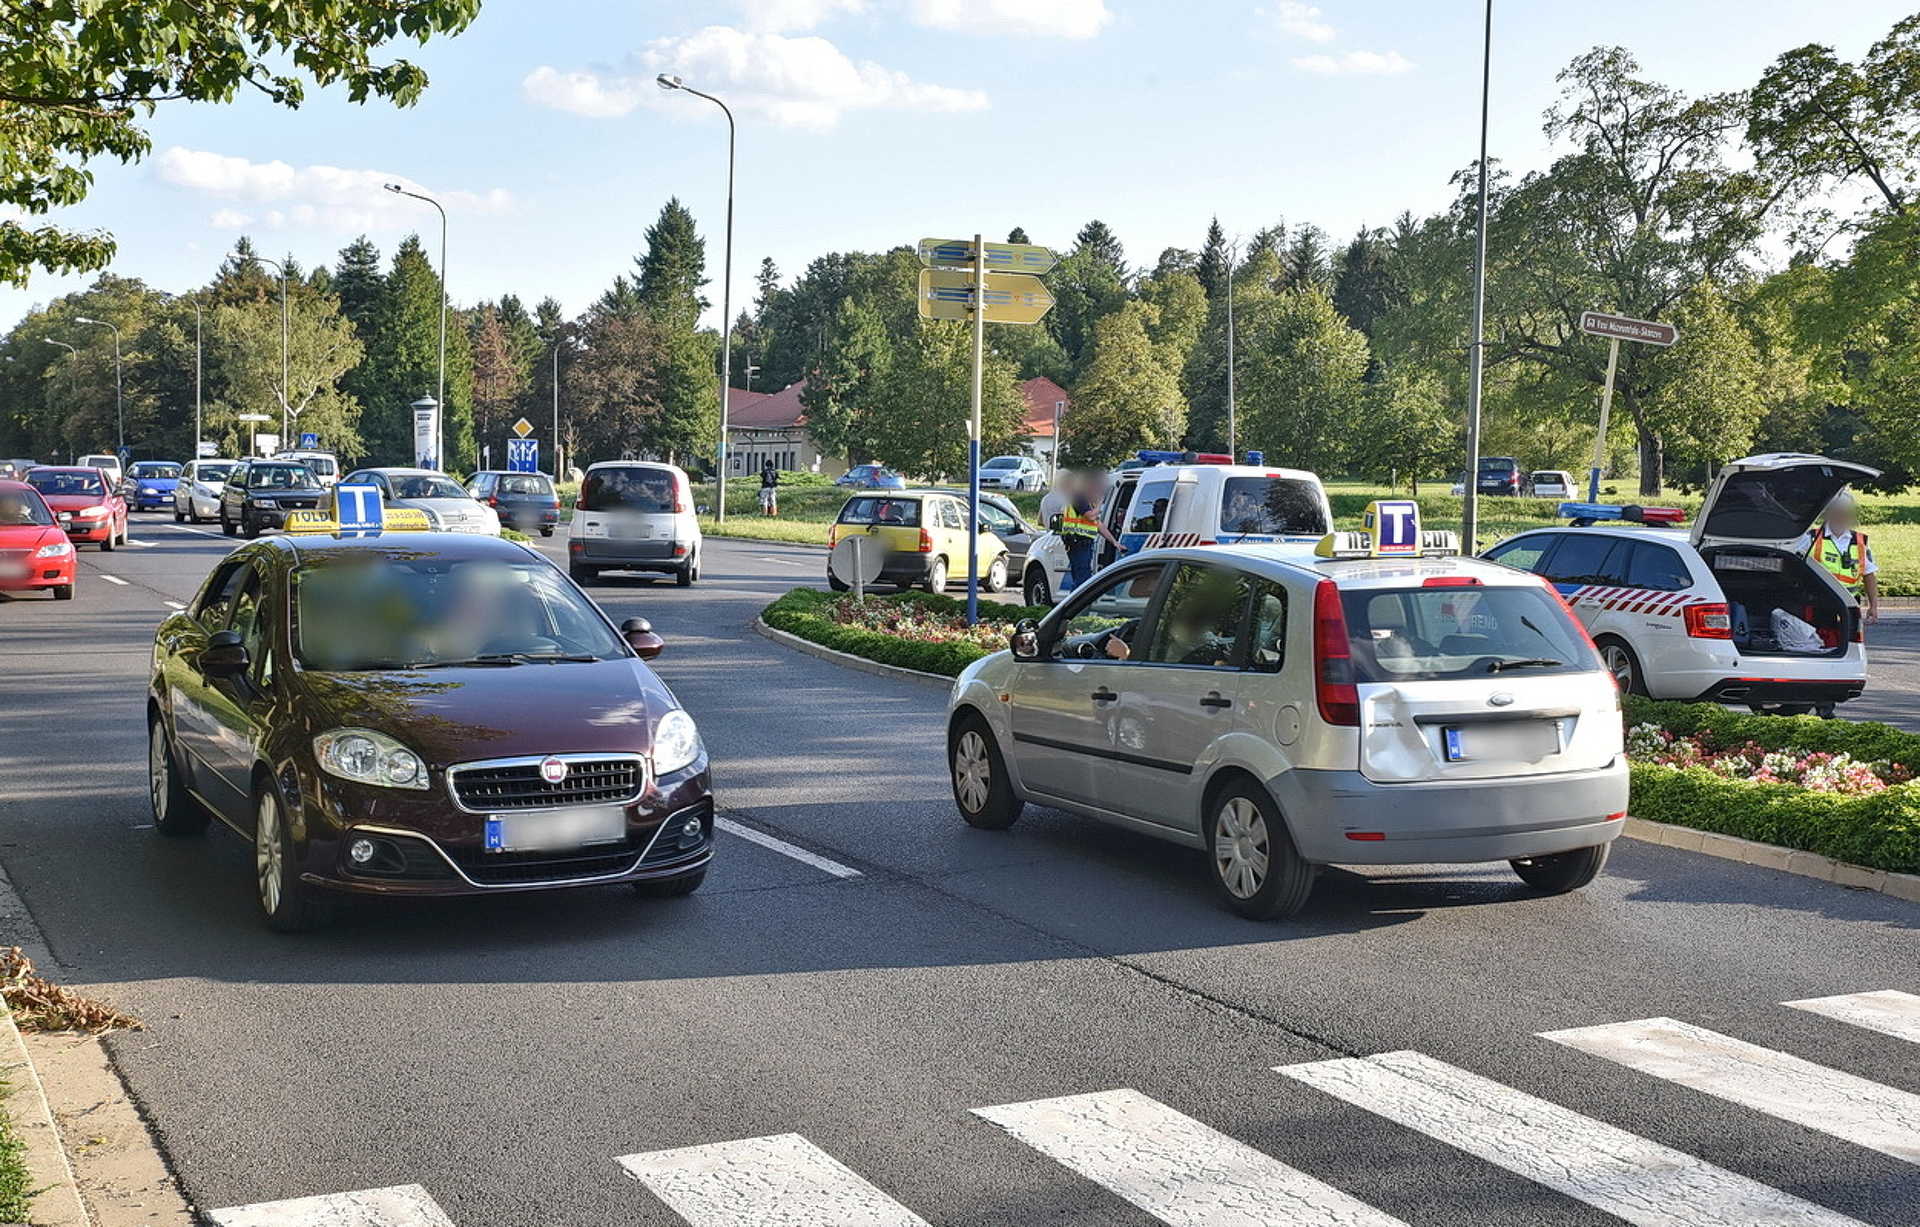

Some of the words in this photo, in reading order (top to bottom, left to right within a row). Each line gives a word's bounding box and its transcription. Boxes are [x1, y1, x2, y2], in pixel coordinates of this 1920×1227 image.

[339, 486, 376, 522] T
[1382, 505, 1413, 544] T
[490, 835, 498, 845] H
